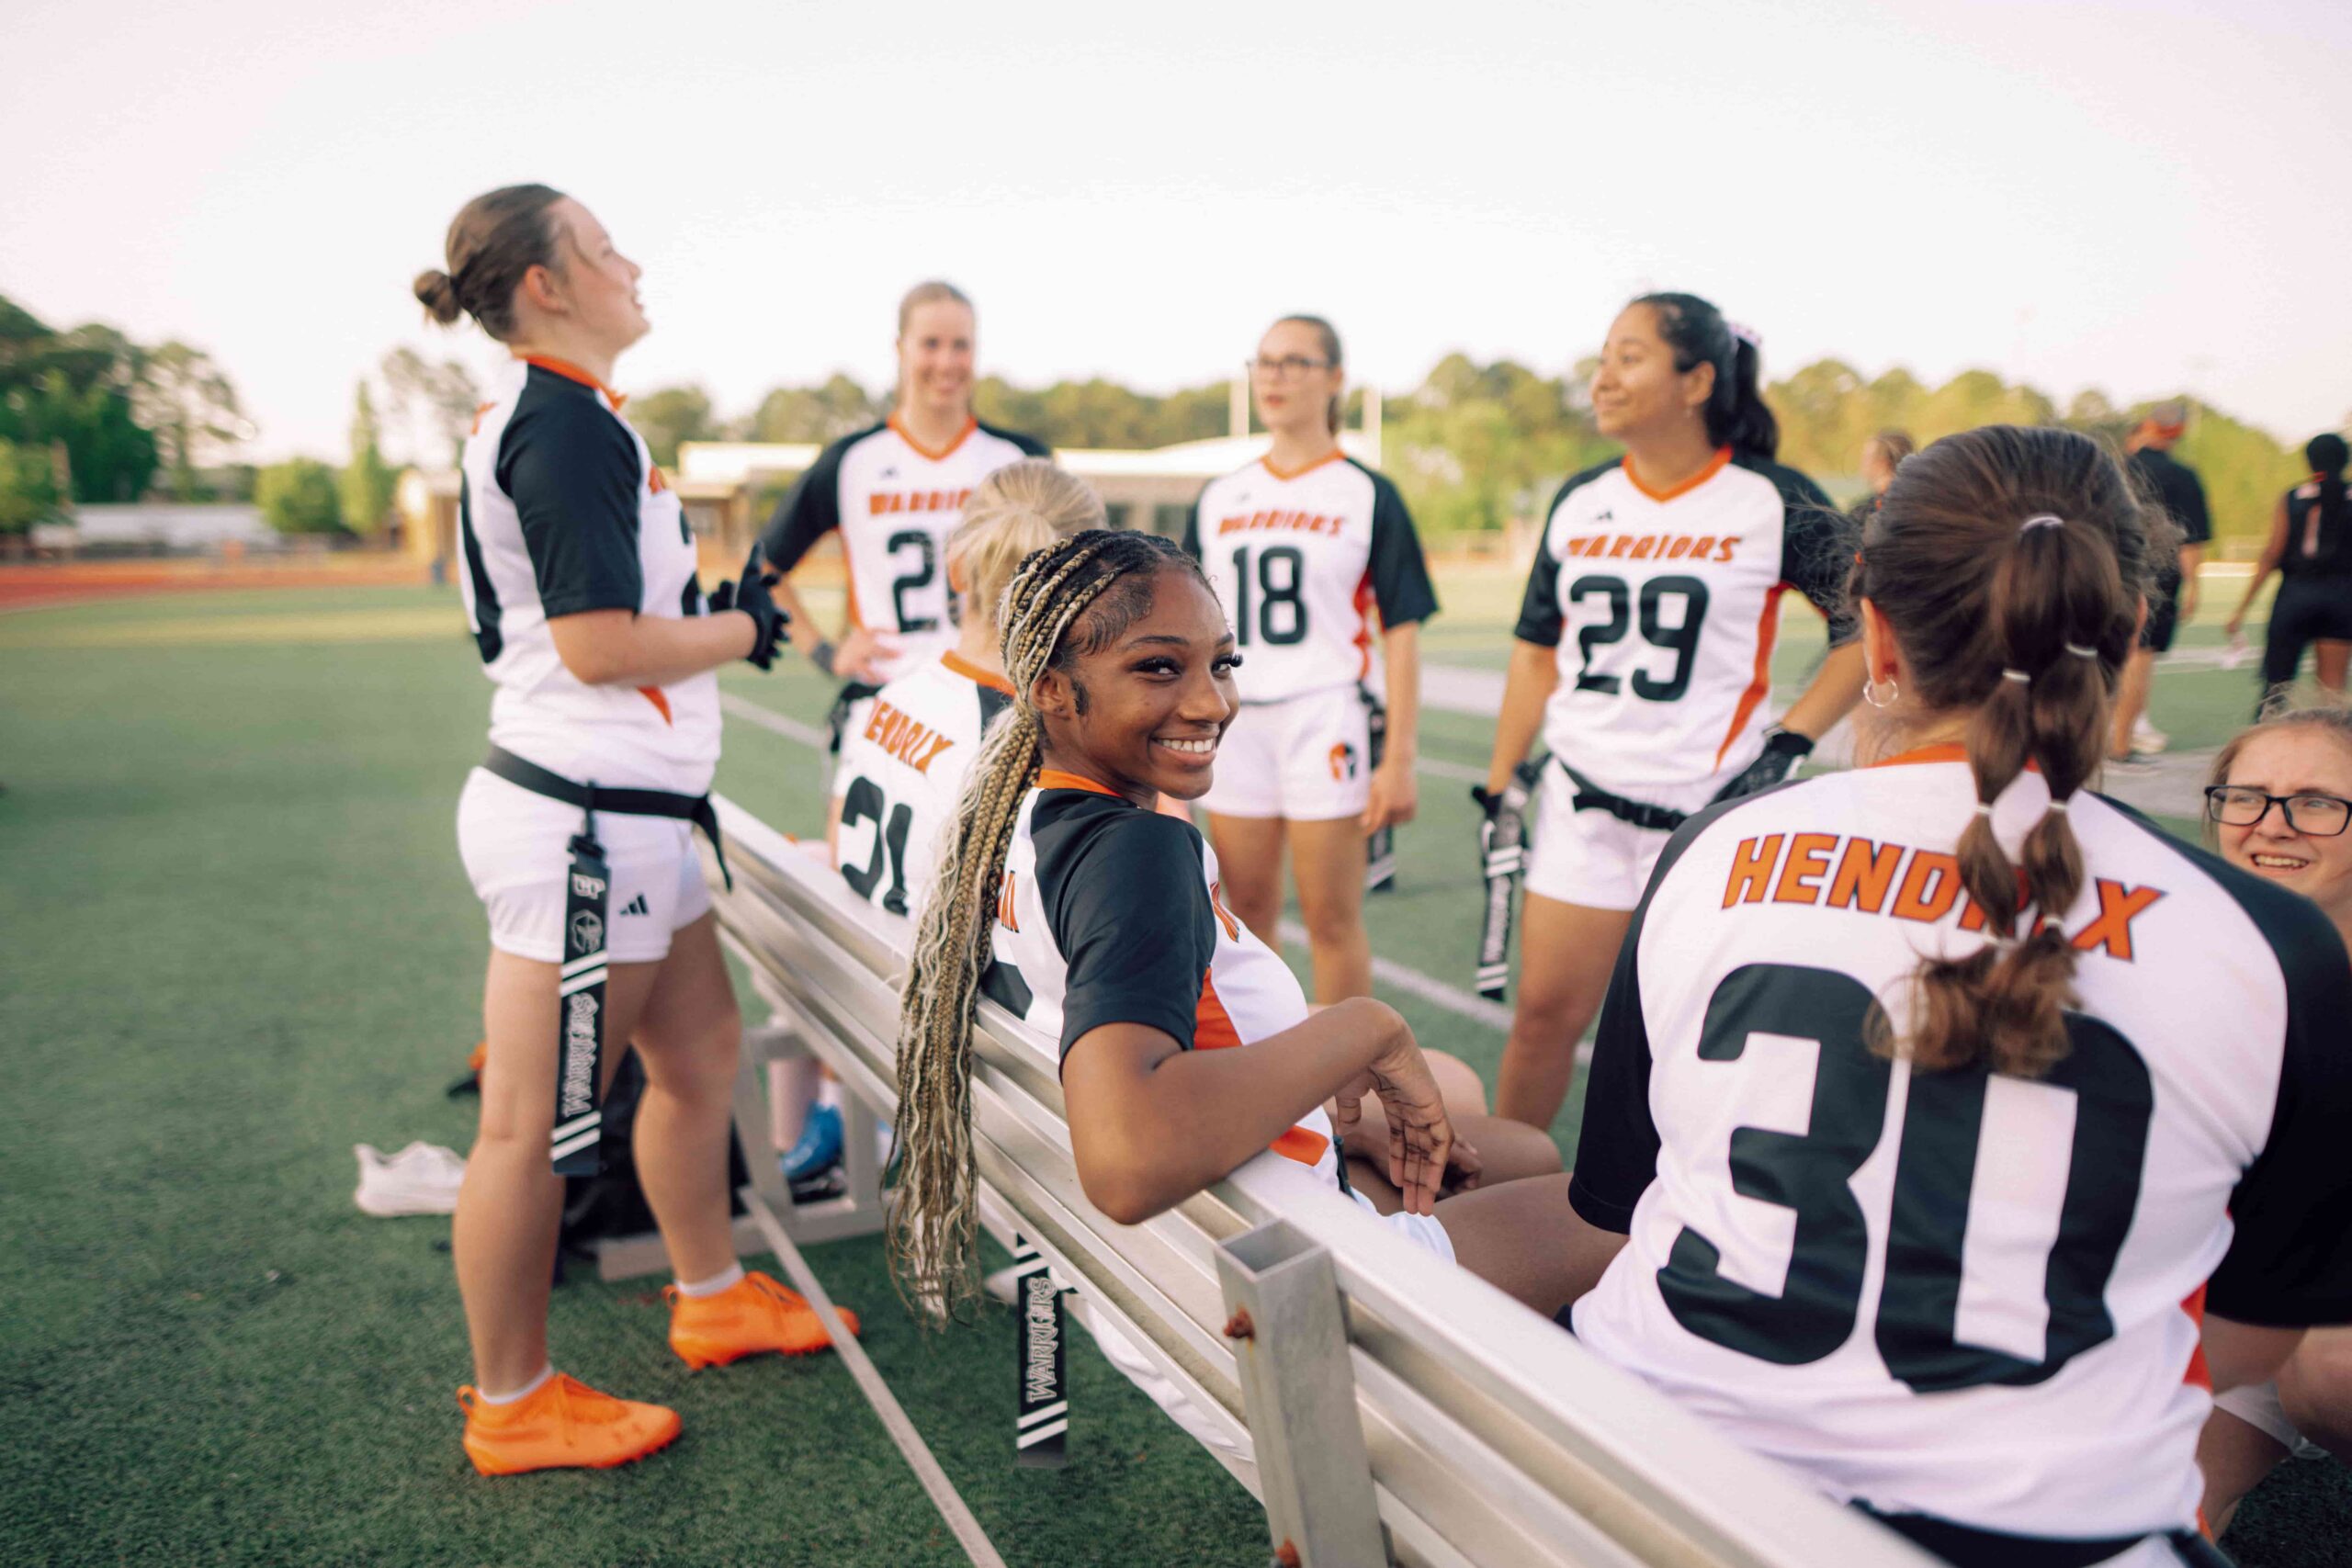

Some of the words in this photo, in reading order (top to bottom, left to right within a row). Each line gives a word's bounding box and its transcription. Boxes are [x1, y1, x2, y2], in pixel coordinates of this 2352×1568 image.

[887, 529, 962, 632] 2
[1233, 546, 1308, 646] 18
[1567, 535, 1741, 562] WARRIORS
[1570, 575, 1710, 702] 29
[864, 696, 955, 774] ENDRIX
[842, 776, 912, 917] 21
[1722, 832, 2167, 962] HENDX
[1657, 963, 2155, 1395] 30
[1026, 1276, 1058, 1404] WARRIORS
